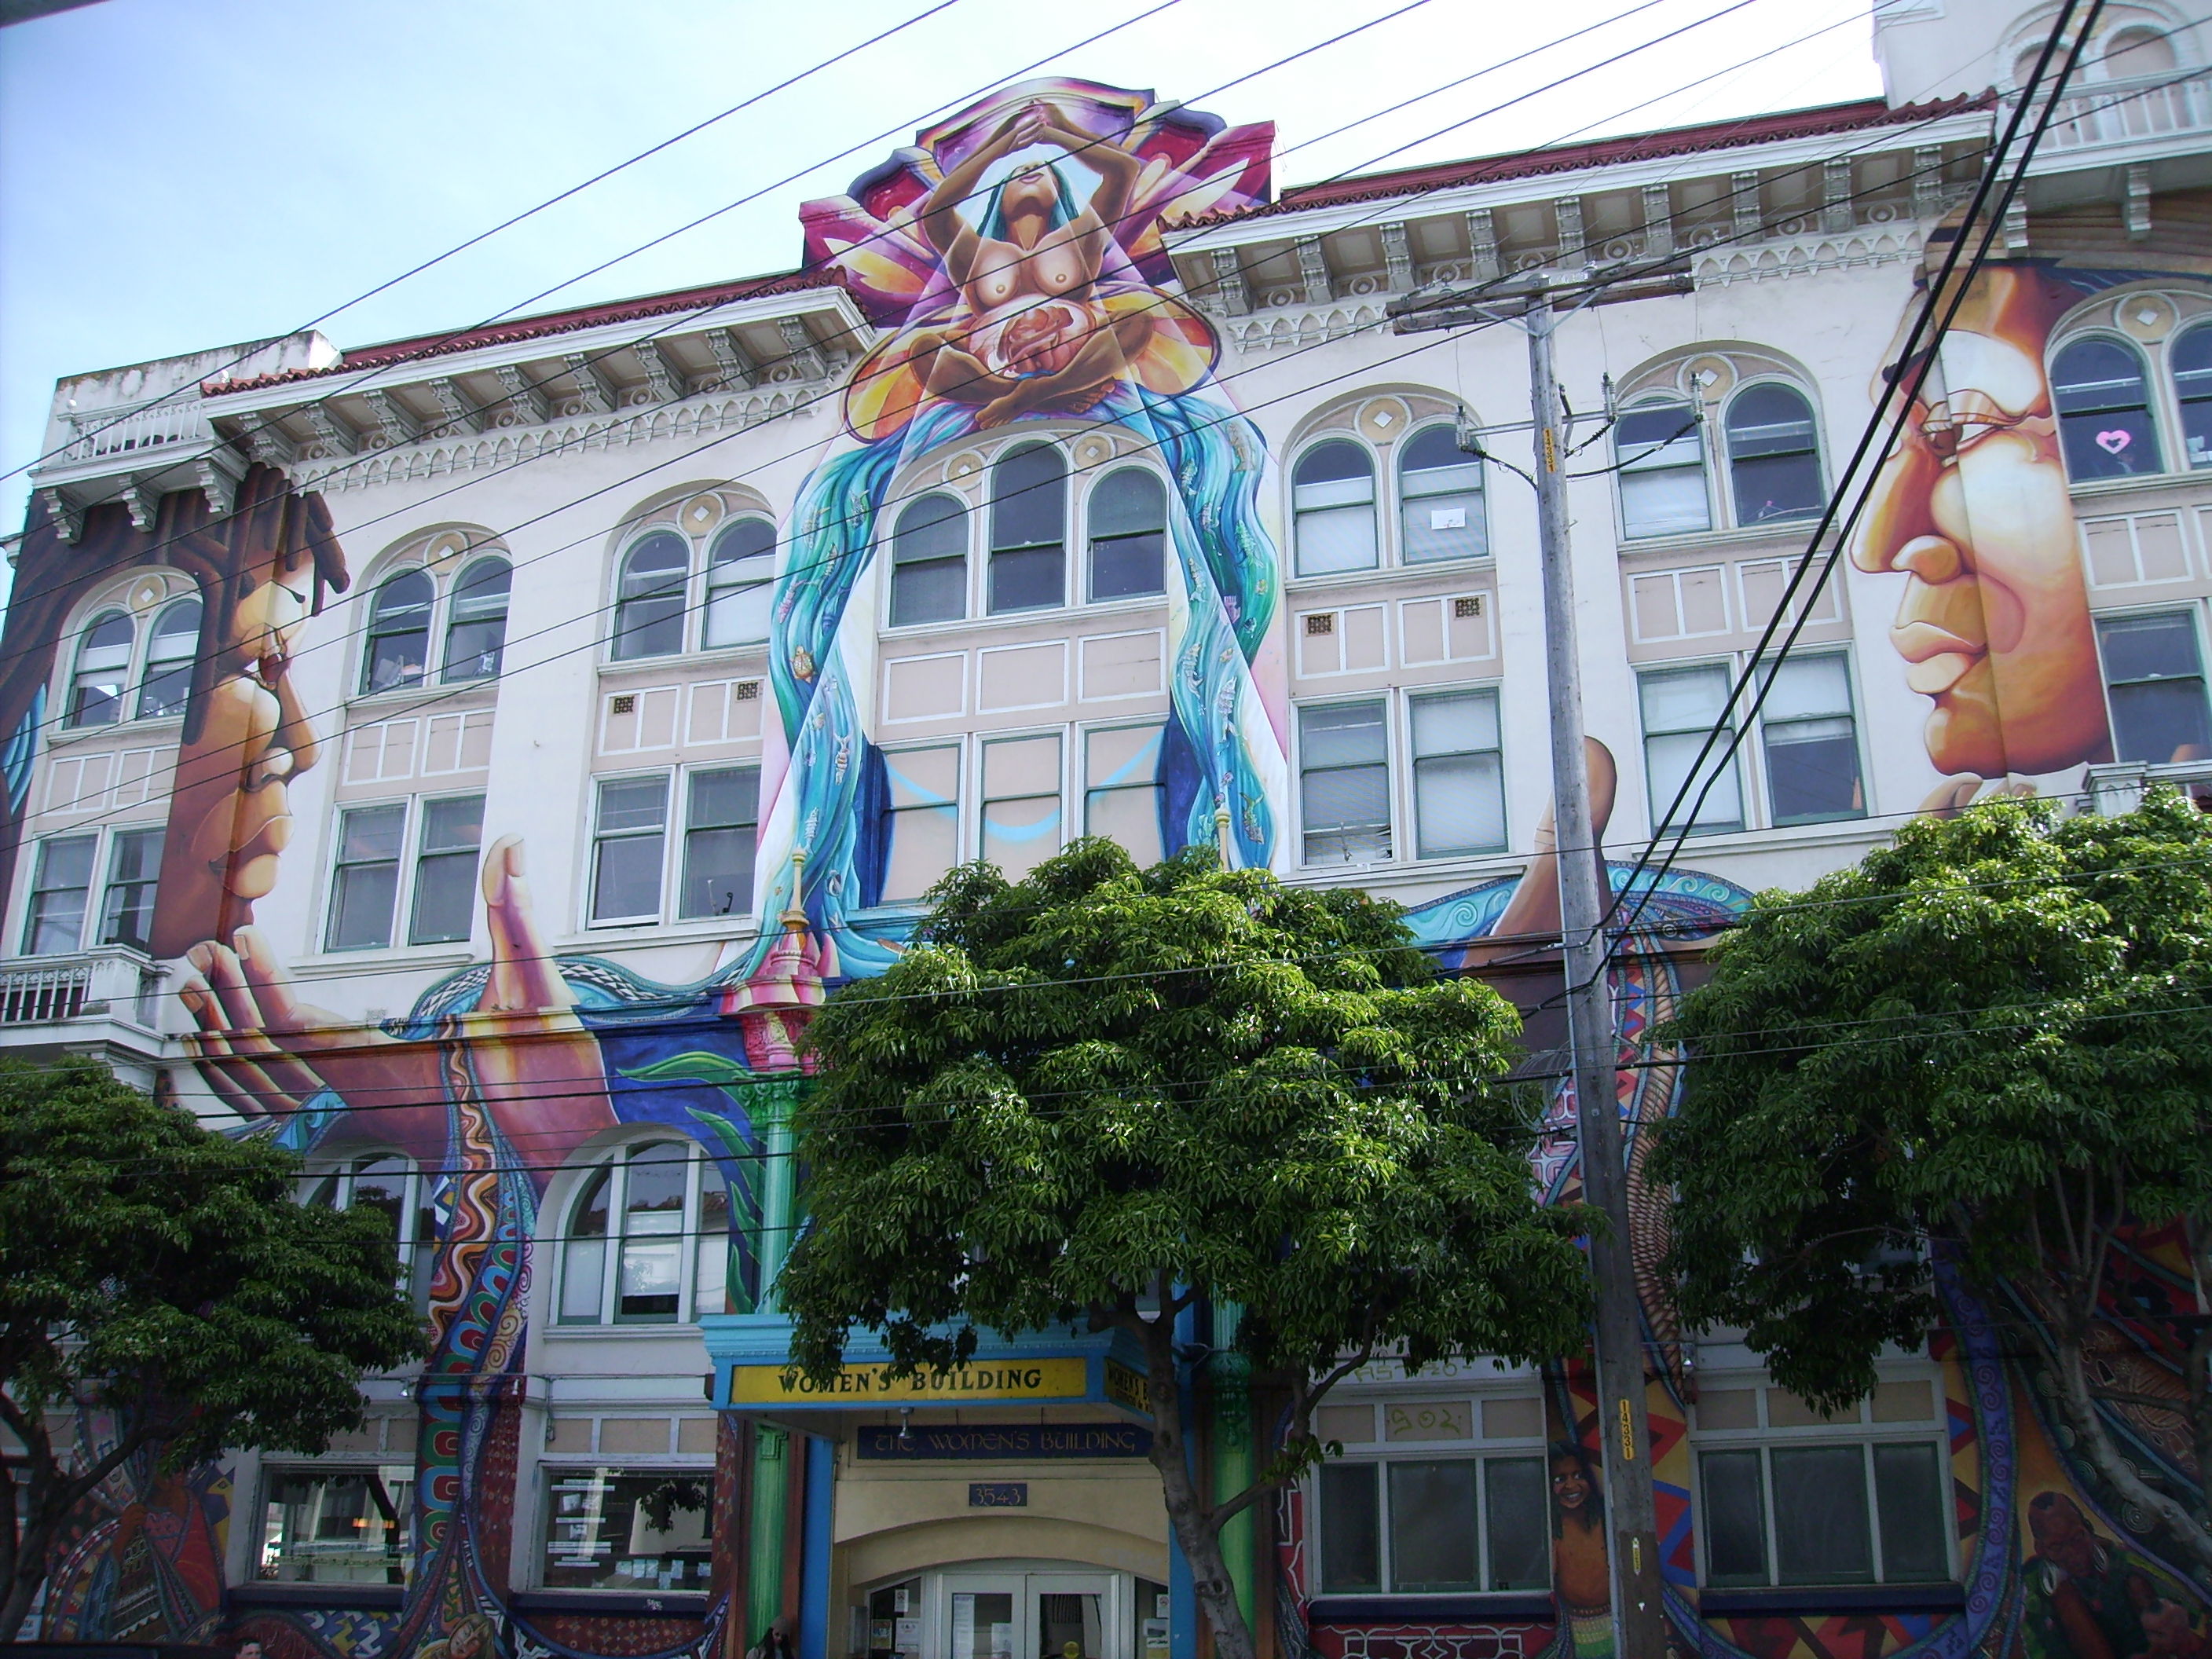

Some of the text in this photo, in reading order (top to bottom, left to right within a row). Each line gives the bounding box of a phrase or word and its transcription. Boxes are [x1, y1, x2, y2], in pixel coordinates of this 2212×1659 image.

[778, 1368, 1042, 1393] WOMEN'S BUILDING
[1622, 1401, 1631, 1458] 14331
[875, 1432, 1136, 1452] THE WOMEN'S BUILDING
[972, 1488, 1020, 1507] 3543
